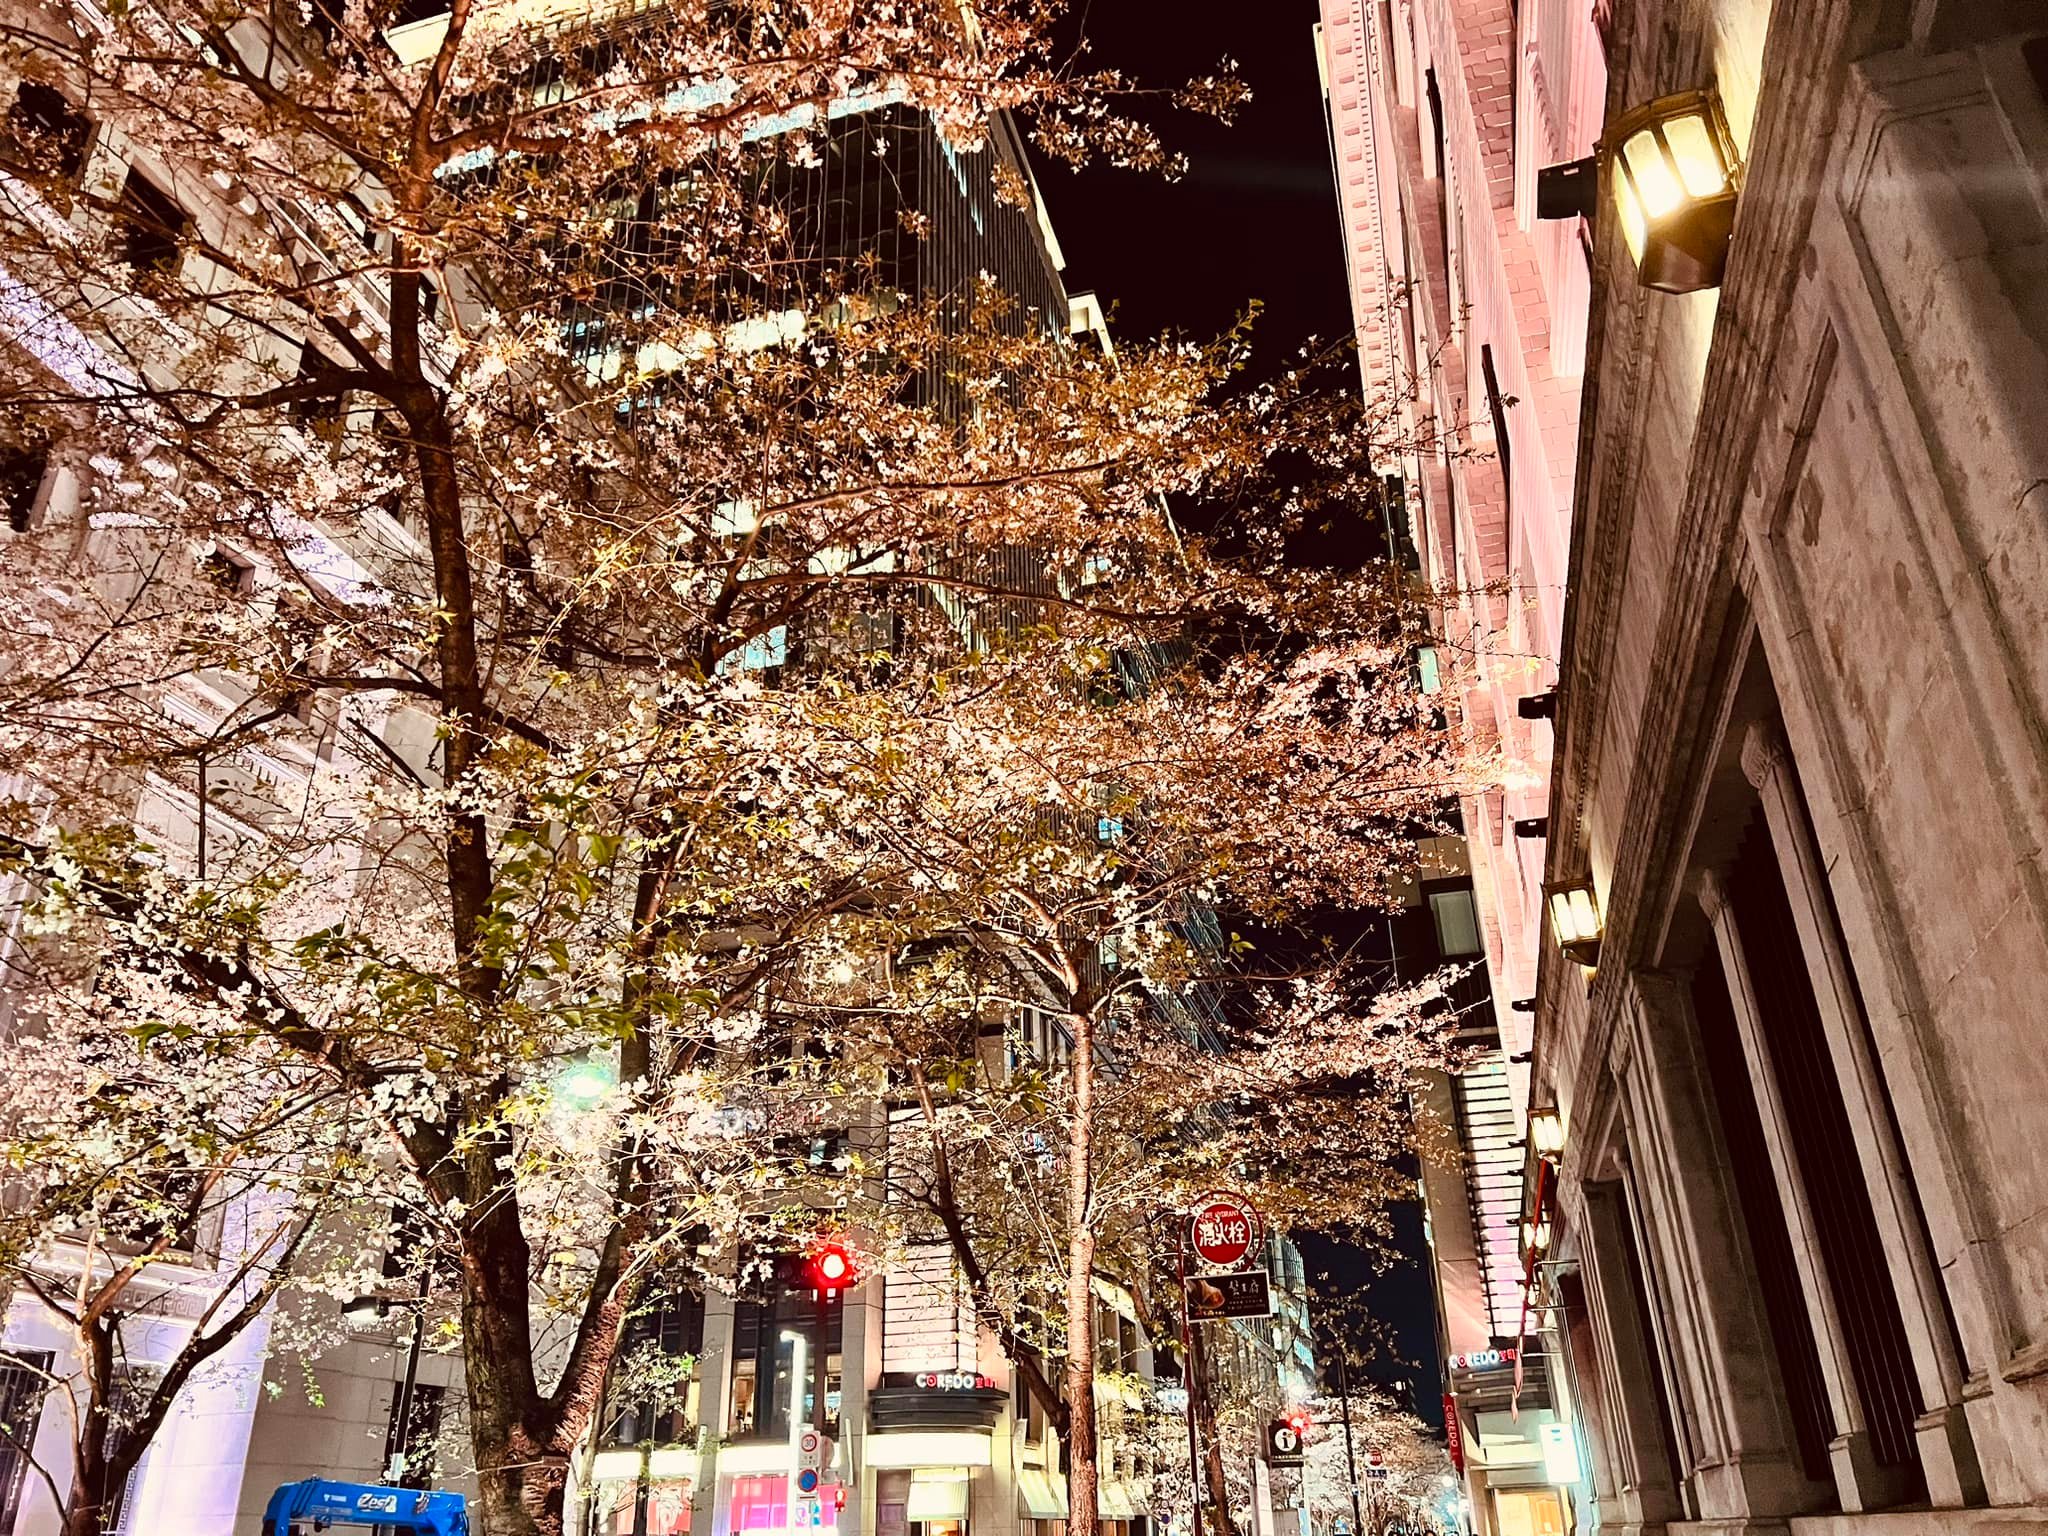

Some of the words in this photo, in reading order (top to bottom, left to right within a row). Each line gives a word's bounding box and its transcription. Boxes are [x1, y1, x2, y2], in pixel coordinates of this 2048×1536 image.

[1198, 1220, 1246, 1246] 消火栓
[1448, 1349, 1499, 1369] COREDO
[916, 1373, 975, 1390] COREDO
[1445, 1404, 1458, 1448] COREDO
